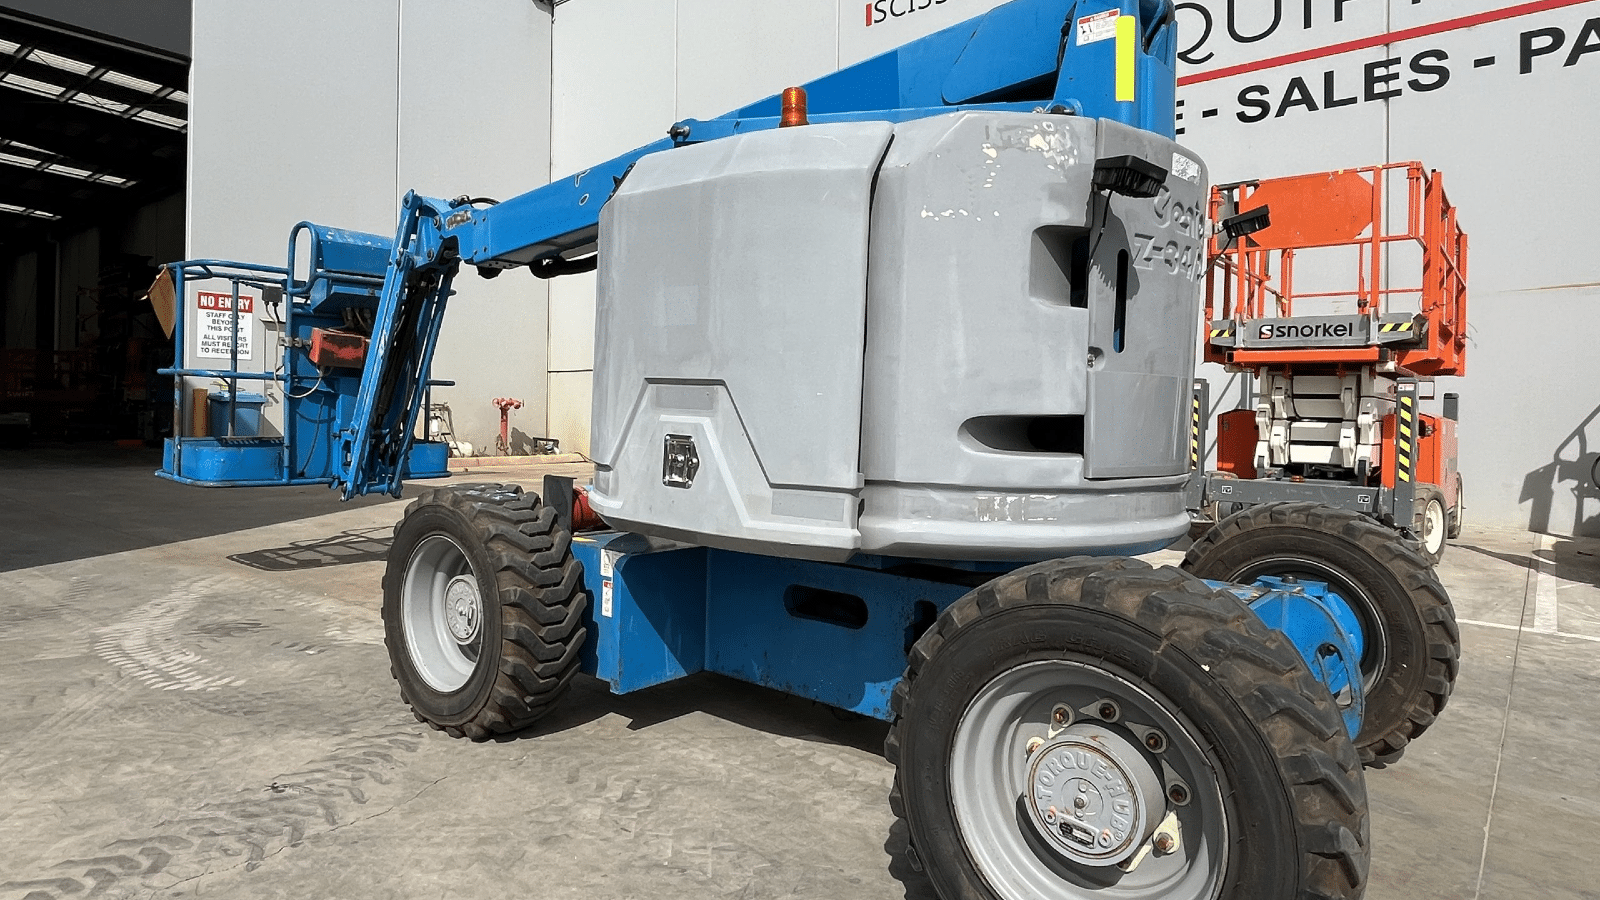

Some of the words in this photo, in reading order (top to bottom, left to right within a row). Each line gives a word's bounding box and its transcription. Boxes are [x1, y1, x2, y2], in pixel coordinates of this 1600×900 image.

[1236, 49, 1451, 124] SALES
[200, 295, 215, 307] NO
[218, 296, 250, 310] ENRY
[1276, 323, 1353, 338] snorkel
